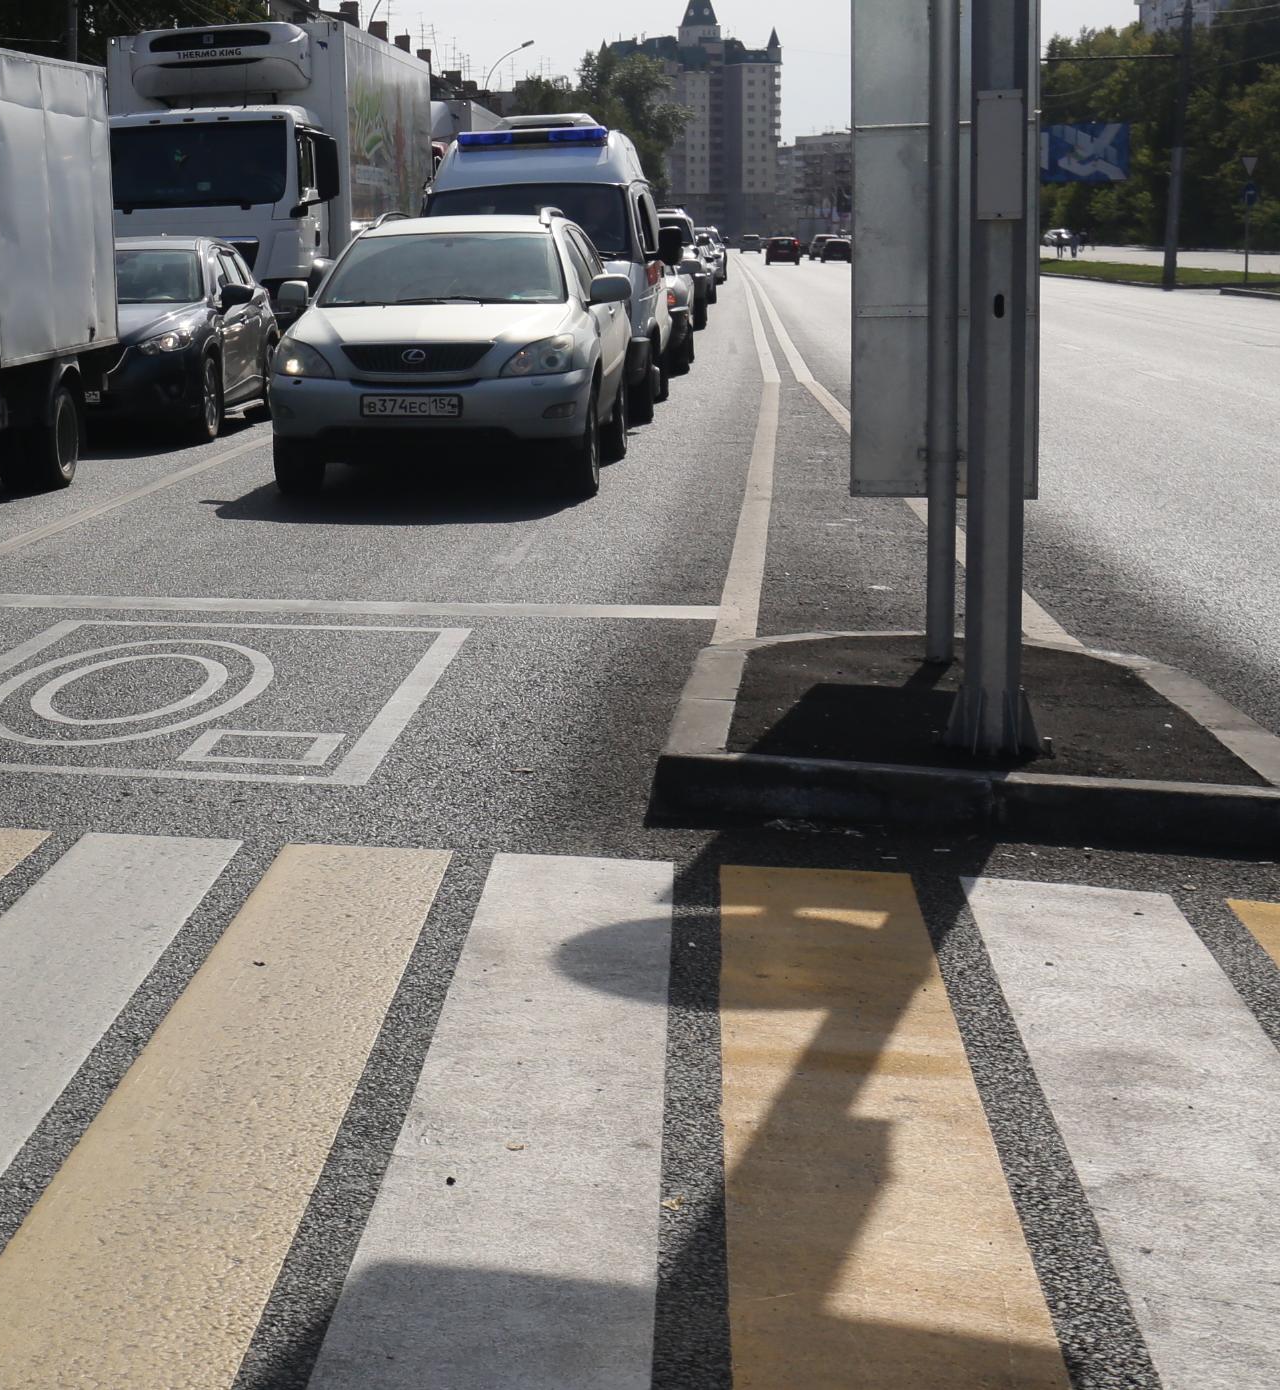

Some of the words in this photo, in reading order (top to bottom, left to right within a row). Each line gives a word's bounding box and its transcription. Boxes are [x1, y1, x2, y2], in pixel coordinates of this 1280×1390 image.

[177, 51, 217, 60] THERMO
[219, 48, 242, 57] KING
[367, 398, 428, 414] В374ЕС
